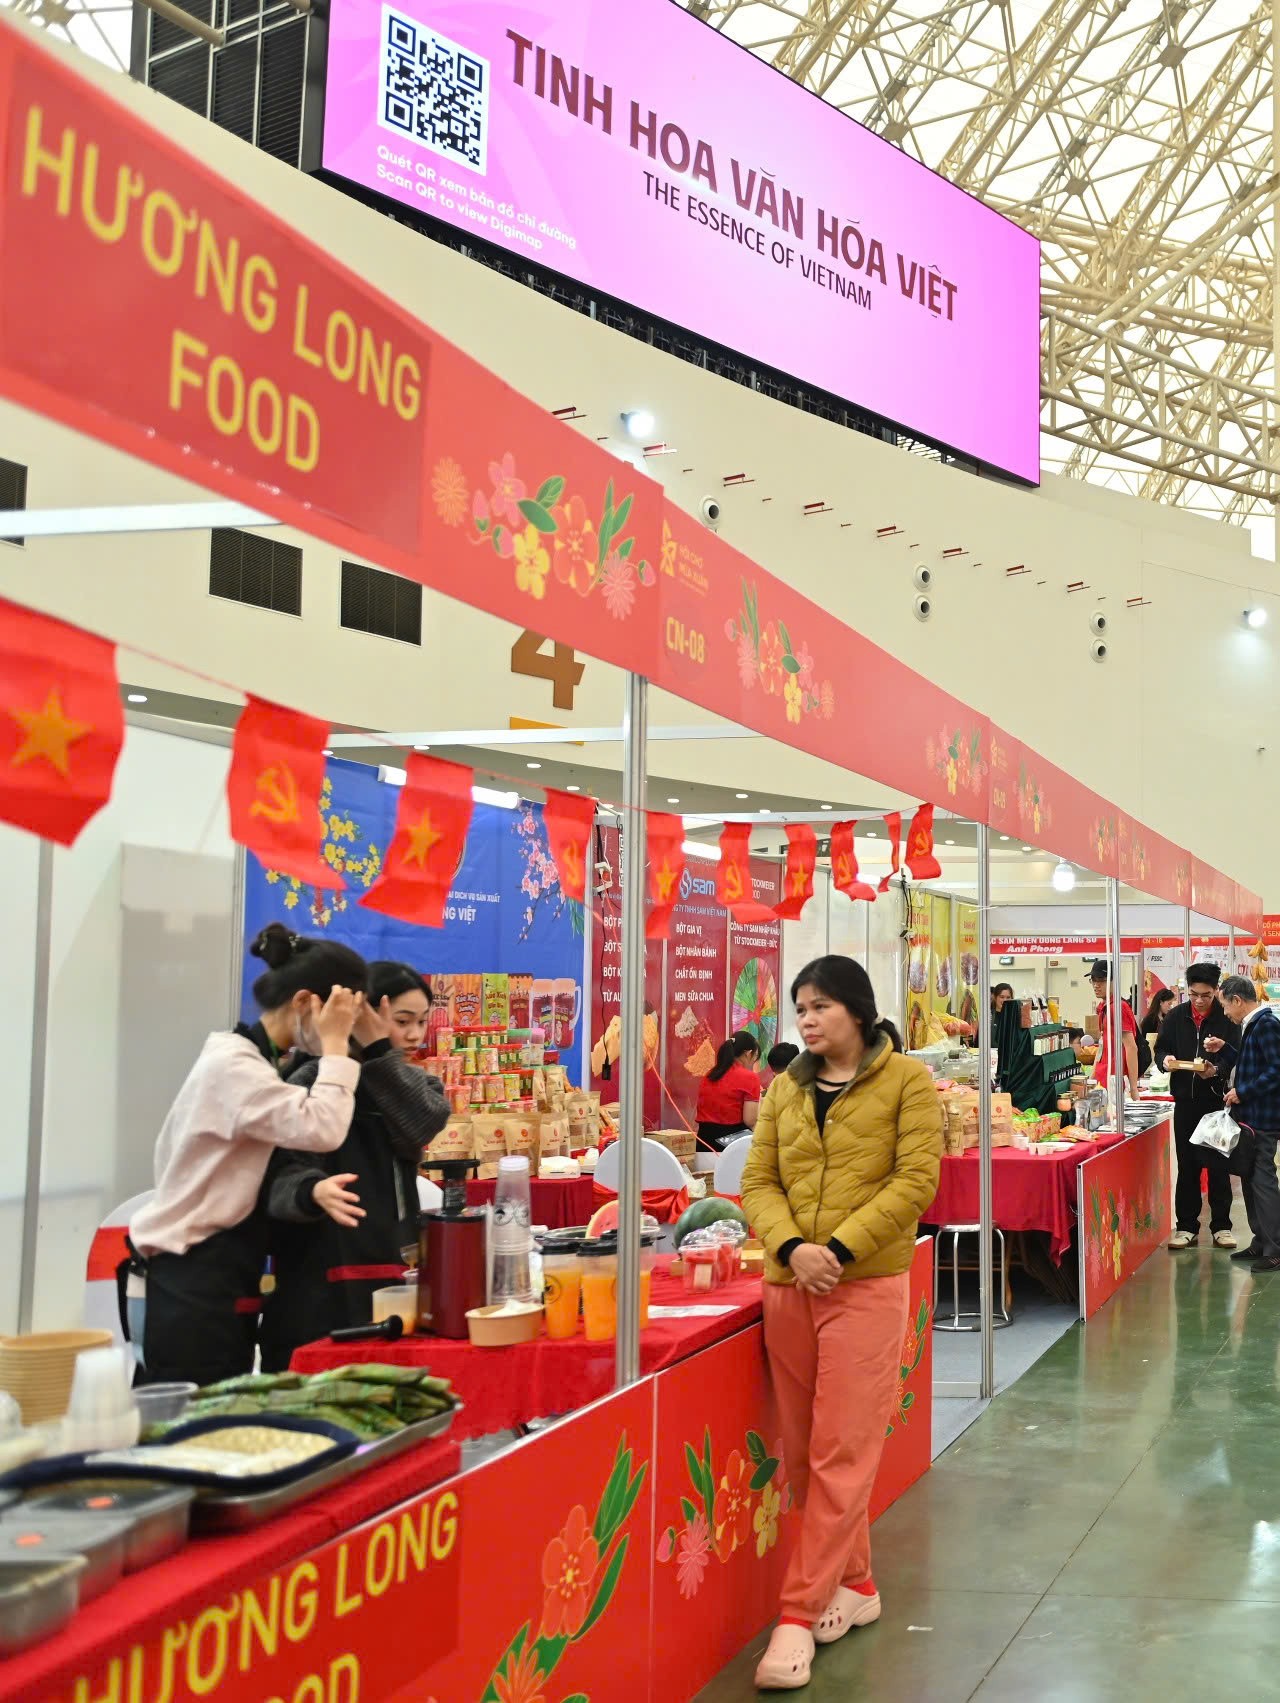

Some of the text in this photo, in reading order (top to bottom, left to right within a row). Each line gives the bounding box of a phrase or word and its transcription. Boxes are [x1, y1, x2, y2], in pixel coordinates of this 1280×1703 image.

[376, 164, 543, 250] Scan QR to view Digimap
[377, 145, 412, 172] Quét
[415, 163, 436, 183] QR
[440, 175, 467, 197] xem
[469, 187, 495, 210] bản
[497, 201, 514, 218] đồ
[538, 219, 577, 250] đường
[506, 28, 614, 135] TINH
[629, 100, 718, 194] HOA
[731, 158, 804, 240] VĂN
[897, 252, 958, 321] VIỆT
[21, 104, 422, 421] HƯƠNG LONG
[643, 170, 872, 311] THE ESSENCE OF VIETNAM
[168, 329, 320, 472] FOOD
[666, 616, 705, 664] CN-08
[458, 905, 476, 924] VIỆT
[692, 878, 715, 896] sam
[752, 877, 775, 891] TOCKMEIER
[603, 964, 617, 980] BỘT
[1006, 944, 1064, 954] Anh Phong
[334, 1491, 458, 1618] LONG
